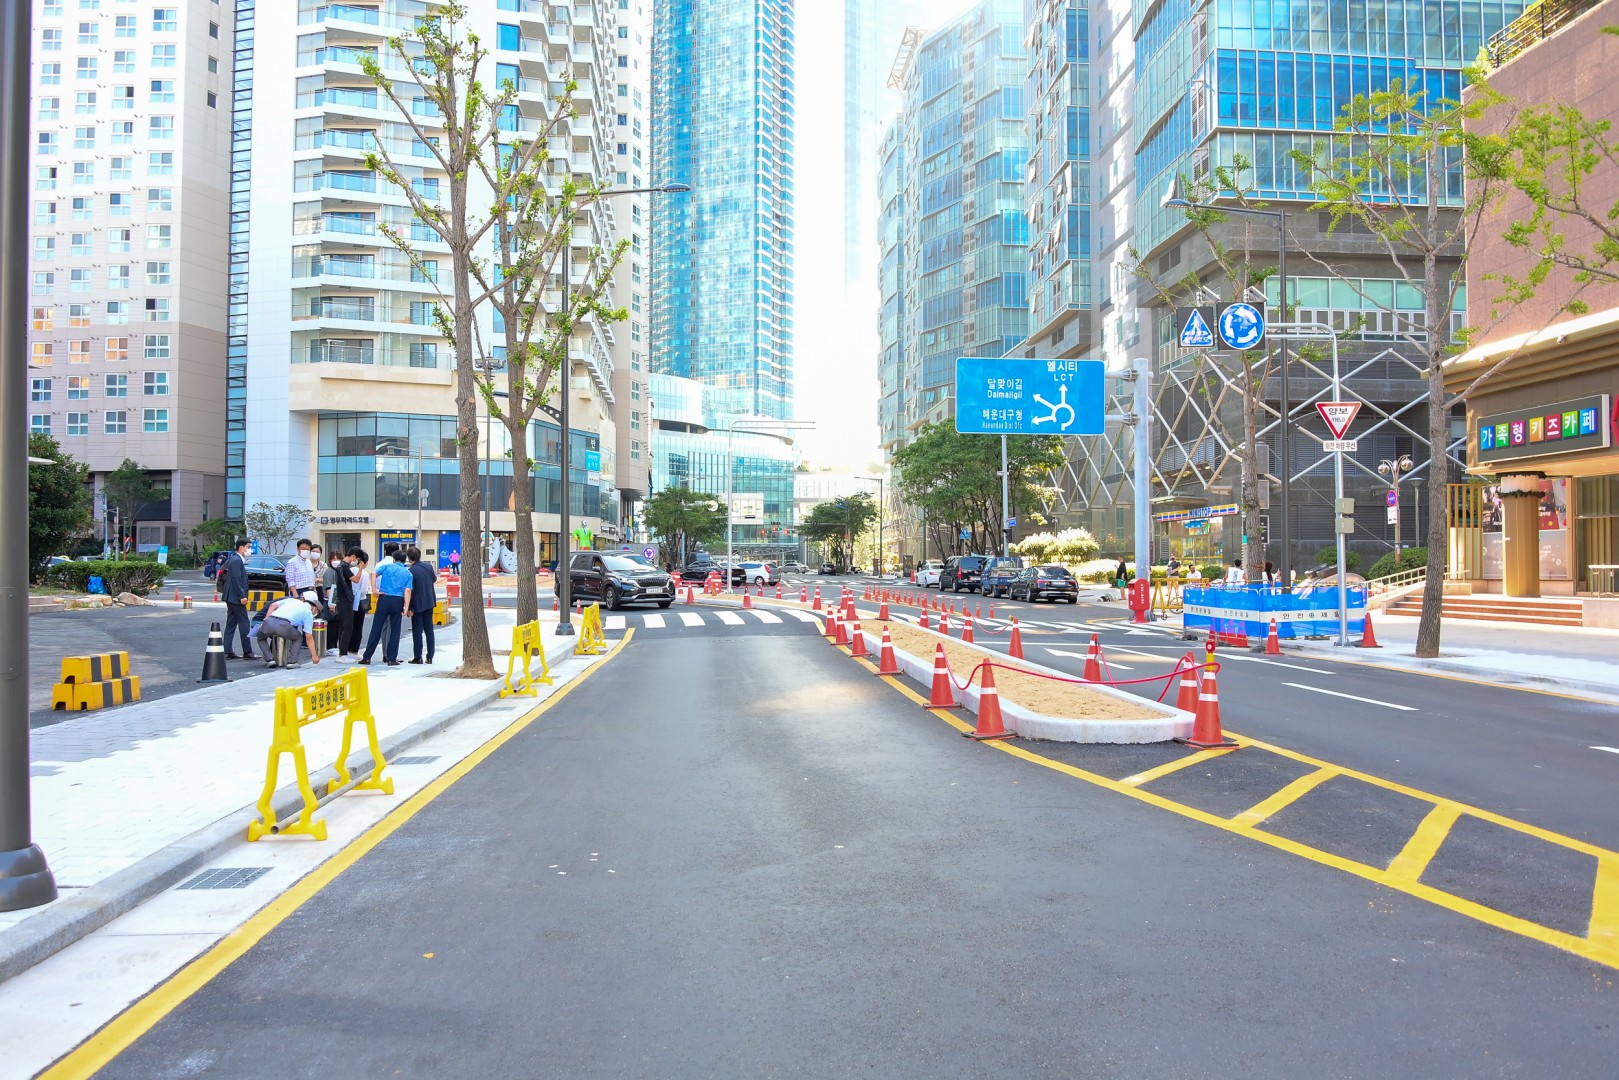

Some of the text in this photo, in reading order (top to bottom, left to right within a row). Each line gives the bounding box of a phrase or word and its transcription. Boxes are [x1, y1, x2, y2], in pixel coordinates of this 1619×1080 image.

[1047, 361, 1078, 372] 엘시티
[1054, 373, 1074, 381] LCT
[987, 378, 1023, 389] 달맞이길
[982, 409, 1023, 420] 해운대구청
[1482, 409, 1595, 447] 가족형 키즈카페
[1346, 441, 1356, 450] 우선
